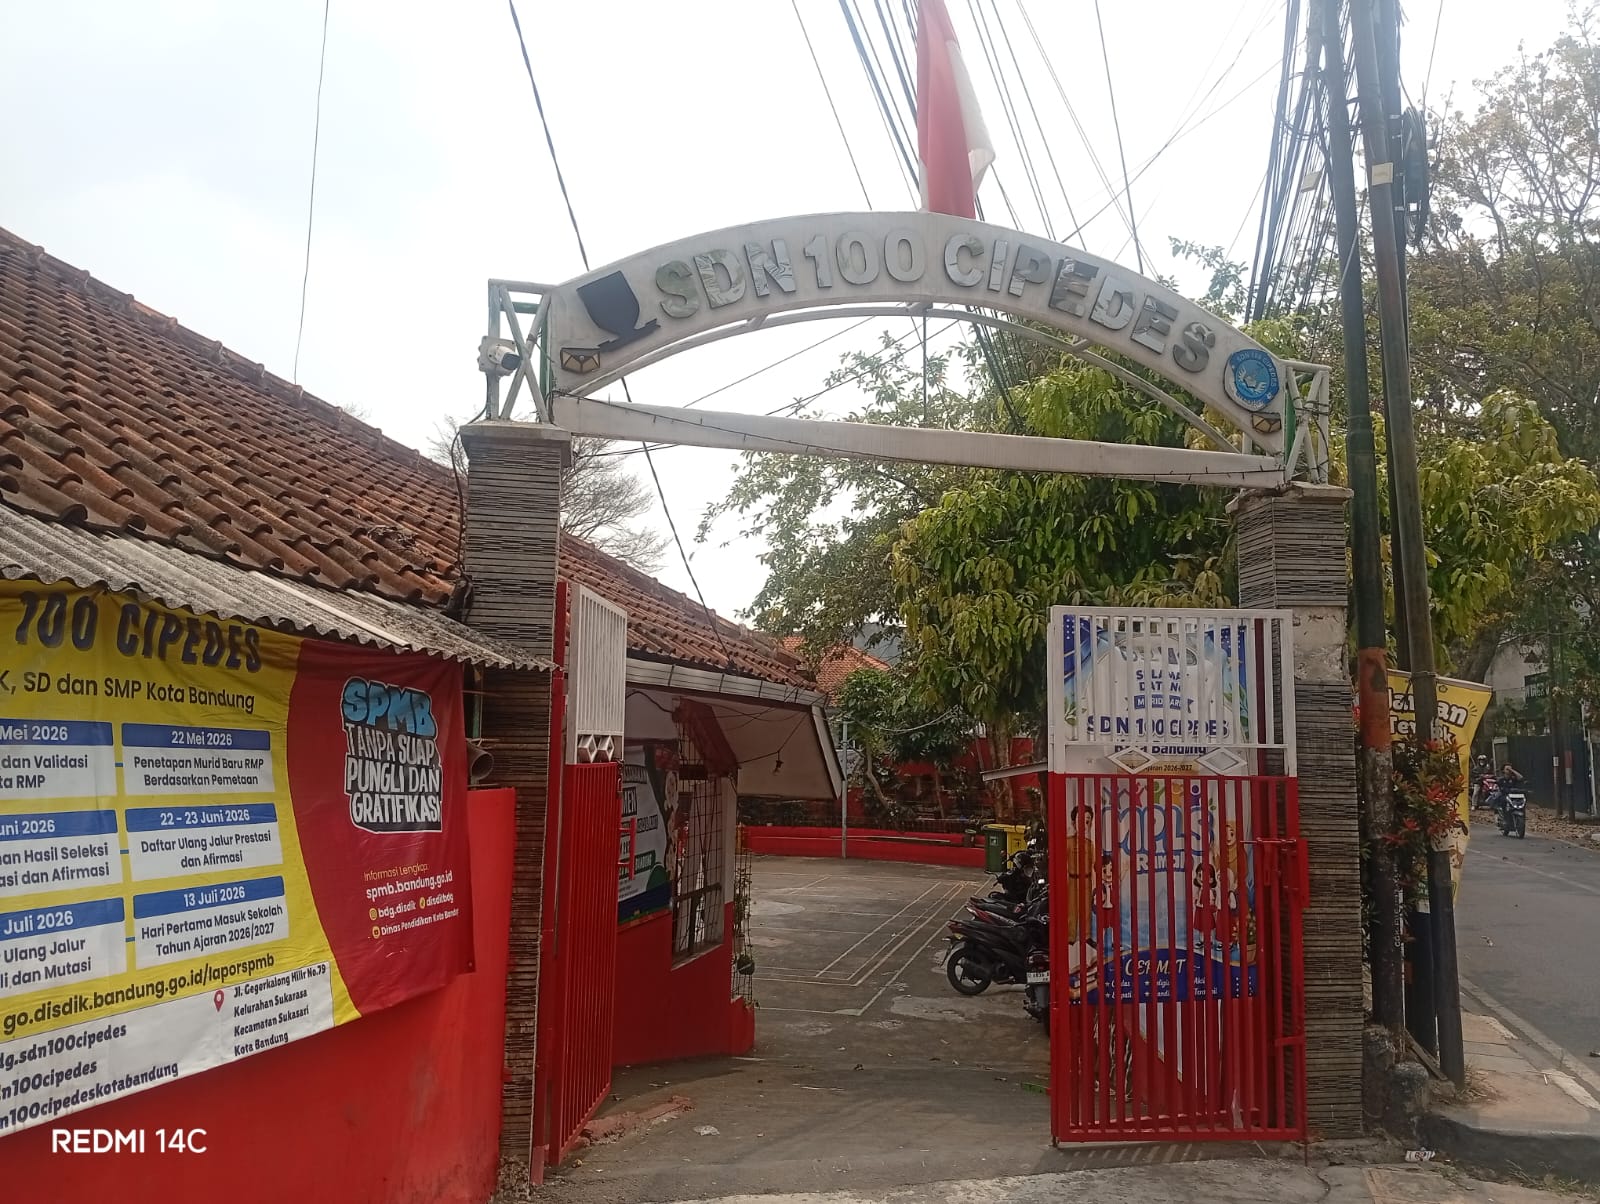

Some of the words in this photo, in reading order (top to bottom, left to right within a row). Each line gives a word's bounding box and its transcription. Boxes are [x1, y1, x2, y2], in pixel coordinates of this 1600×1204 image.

[656, 237, 797, 318] SDN
[804, 229, 925, 289] 100
[942, 233, 1217, 373] CIPEDES
[15, 591, 98, 651] 100
[117, 603, 262, 673] CIPEDES
[23, 671, 51, 693] SD
[57, 673, 98, 696] dan
[104, 677, 142, 699] SMP
[146, 682, 185, 703] Kota
[188, 687, 255, 714] Bandung
[344, 681, 436, 737] SPMB
[0, 725, 28, 740] Mei
[32, 725, 68, 741] 2026
[171, 731, 185, 744] 22
[186, 731, 205, 745] Mei
[206, 732, 233, 746] 2026
[346, 723, 395, 762] TANPA
[1, 755, 31, 769] dan
[34, 755, 88, 769] Validasi
[134, 757, 192, 771] Penetapan
[193, 757, 221, 769] Murid
[222, 758, 243, 769] Baru
[244, 758, 264, 770] RMP
[16, 775, 45, 788] RMP
[144, 774, 210, 786] Berdasarkan
[211, 774, 258, 785] Pemetaan
[347, 757, 405, 793] PUNGLI
[408, 766, 440, 793] DAN
[160, 813, 175, 826] 22
[184, 812, 199, 825] 23
[200, 810, 224, 824] Juni
[225, 808, 250, 822] 2026
[352, 792, 440, 824] GRATIFIKASI
[22, 819, 56, 834] 2026
[0, 853, 21, 866] an
[24, 846, 58, 863] Hasil
[61, 842, 109, 860] Seleksi
[141, 840, 176, 853] Daftar
[178, 838, 207, 853] Ulang
[209, 834, 233, 847] Jalur
[235, 831, 271, 845] Prestasi
[181, 855, 202, 869] dan
[203, 850, 243, 866] Afirmasi
[21, 871, 49, 885] dan
[52, 862, 110, 882] Afirmasi
[363, 866, 399, 881] Informasi
[366, 870, 453, 902] spmb.bandung.go.id
[183, 893, 196, 907] 13
[198, 890, 218, 905] Juli
[219, 886, 246, 903] 2026
[378, 900, 416, 918] bdg.disdik
[3, 915, 34, 935] Juli
[37, 910, 74, 930] 2026
[141, 924, 165, 940] Hari
[167, 919, 213, 936] Pertama
[214, 911, 246, 927] Masuk
[247, 904, 283, 920] Sekolah
[381, 924, 400, 936] Dinas
[401, 916, 432, 931] Pendidikan
[4, 945, 46, 962] Ulang
[50, 938, 85, 956] Jalur
[156, 940, 191, 957] Tahun
[193, 934, 227, 951] Ajaran
[229, 922, 275, 943] 2026/2027
[12, 970, 41, 986] dan
[44, 956, 91, 980] Mutasi
[245, 975, 290, 995] Gegerkalong
[307, 964, 326, 978] No.79
[3, 953, 274, 1036] go.disdik.bandung.go.id/laporspmb
[234, 999, 273, 1018] Kelurahan
[275, 989, 308, 1006] Sukarasa
[234, 1017, 277, 1037] Kecamatan
[278, 1005, 309, 1024] Sukasari
[234, 1044, 254, 1057] Kota
[255, 1032, 288, 1050] Bandung
[0, 1061, 98, 1100] n100cipedes
